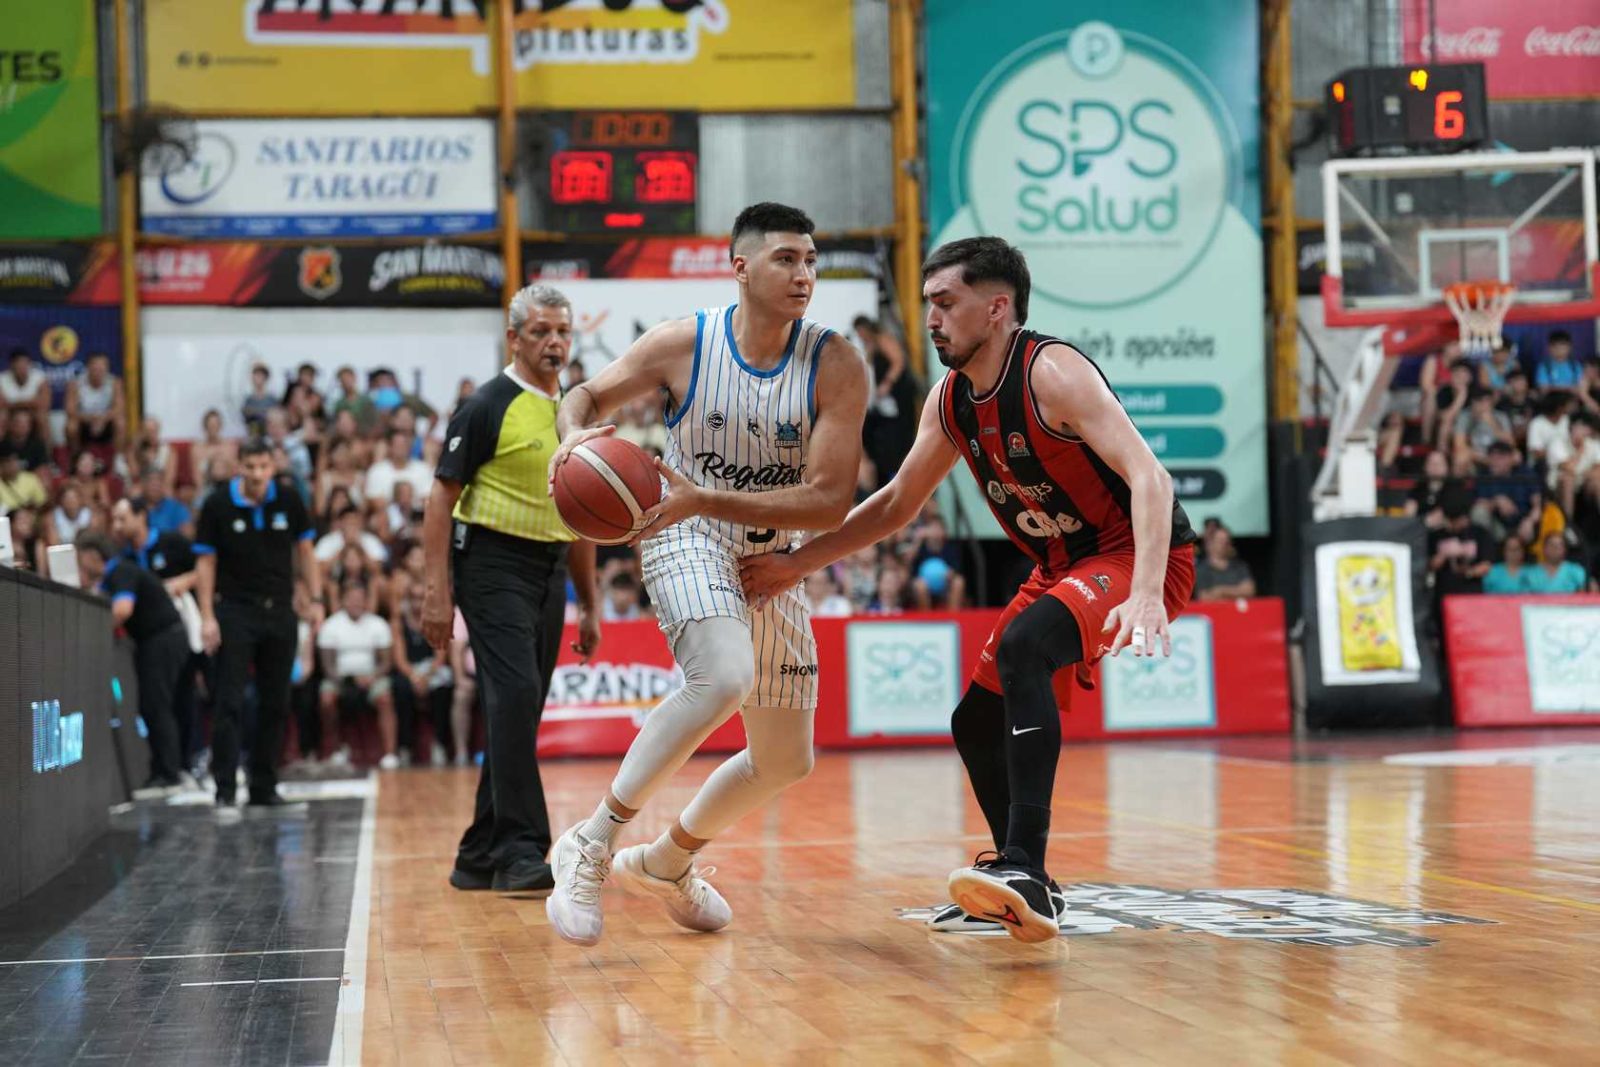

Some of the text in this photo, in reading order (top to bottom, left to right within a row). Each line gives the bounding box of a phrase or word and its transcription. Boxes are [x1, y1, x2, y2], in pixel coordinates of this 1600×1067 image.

[515, 26, 690, 58] pinturas
[1434, 91, 1464, 139] 6
[256, 137, 475, 165] SANITARIOS
[1016, 100, 1178, 178] SPS
[1017, 182, 1179, 233] Salud
[865, 641, 943, 682] SPS
